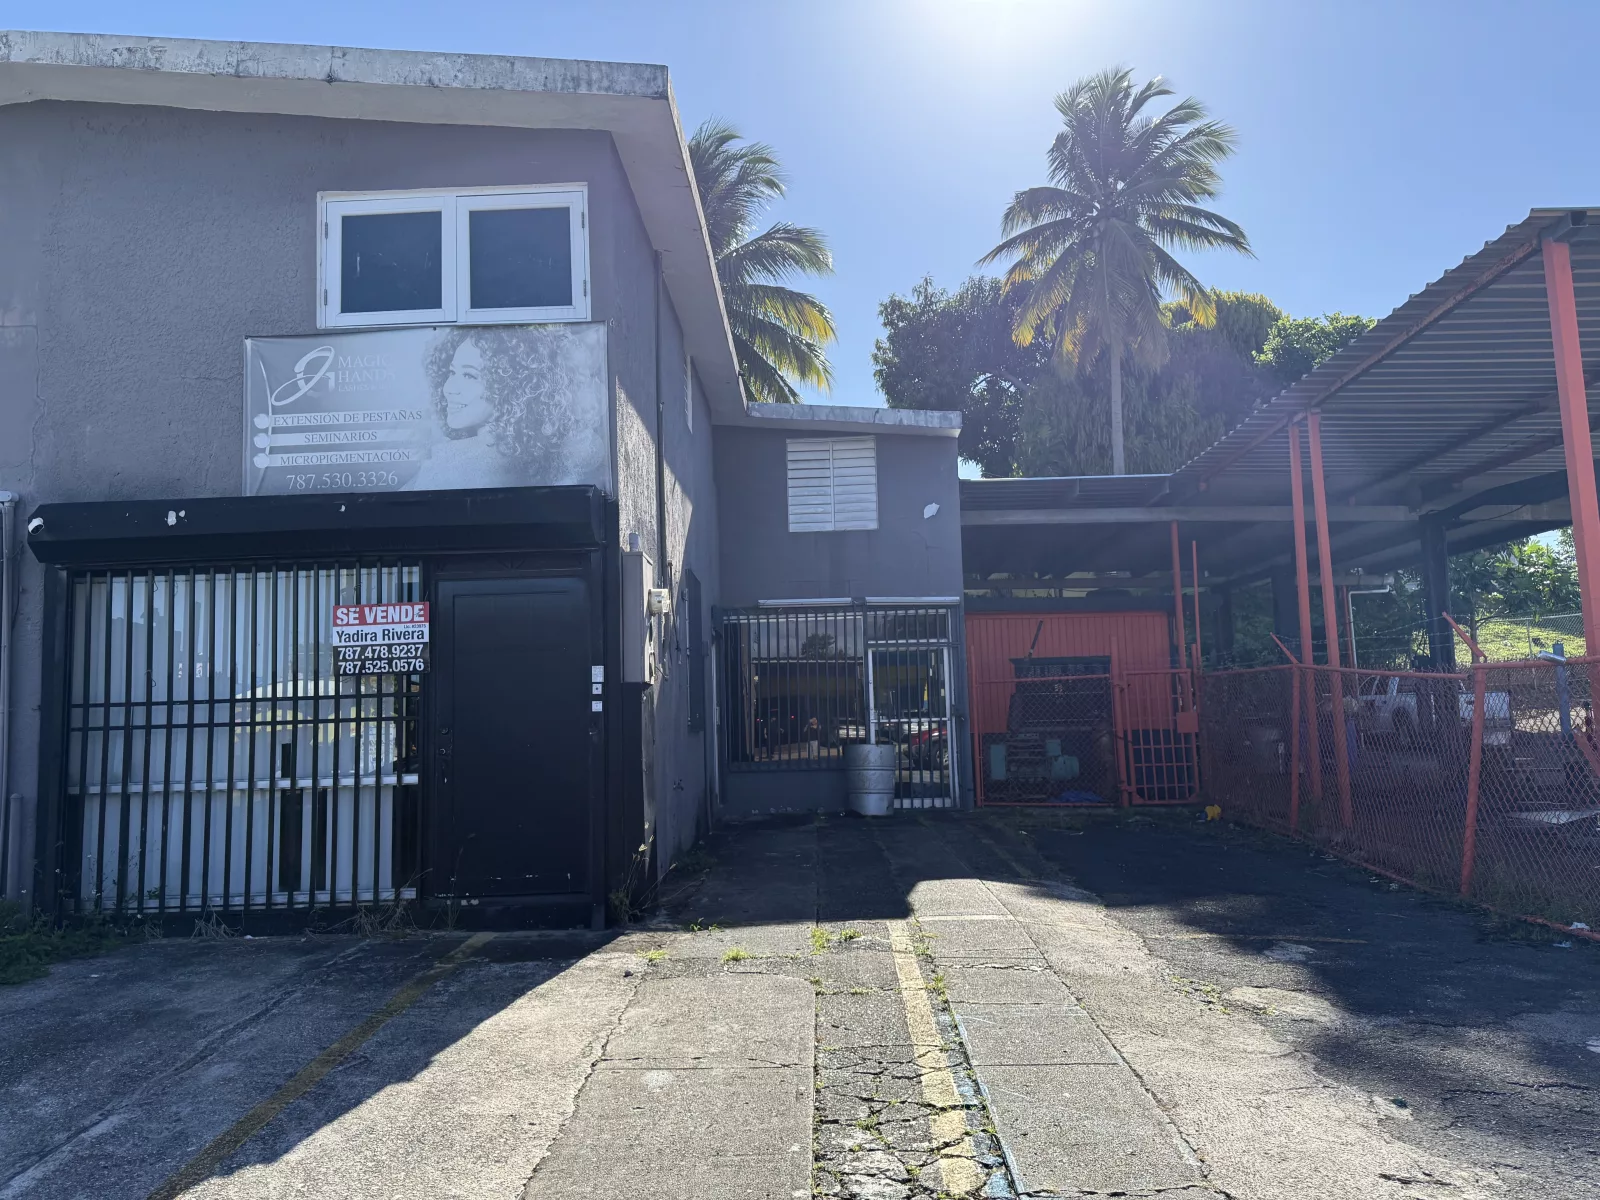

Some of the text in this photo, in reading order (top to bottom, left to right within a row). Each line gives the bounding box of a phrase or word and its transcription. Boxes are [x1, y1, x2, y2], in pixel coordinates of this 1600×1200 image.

[338, 354, 393, 368] MAGIC
[273, 409, 422, 426] EXTENSIÓN DE PESTAÑAS
[304, 431, 378, 444] SEMINARIOS
[280, 449, 410, 466] MICROPIGMENTACIÓN
[286, 470, 398, 490] 787.530.3326
[336, 604, 425, 625] SE VENDE
[336, 628, 424, 643] Yadira Rivera
[338, 644, 424, 660] 787.478.9237
[338, 658, 424, 674] 787.525.0576
